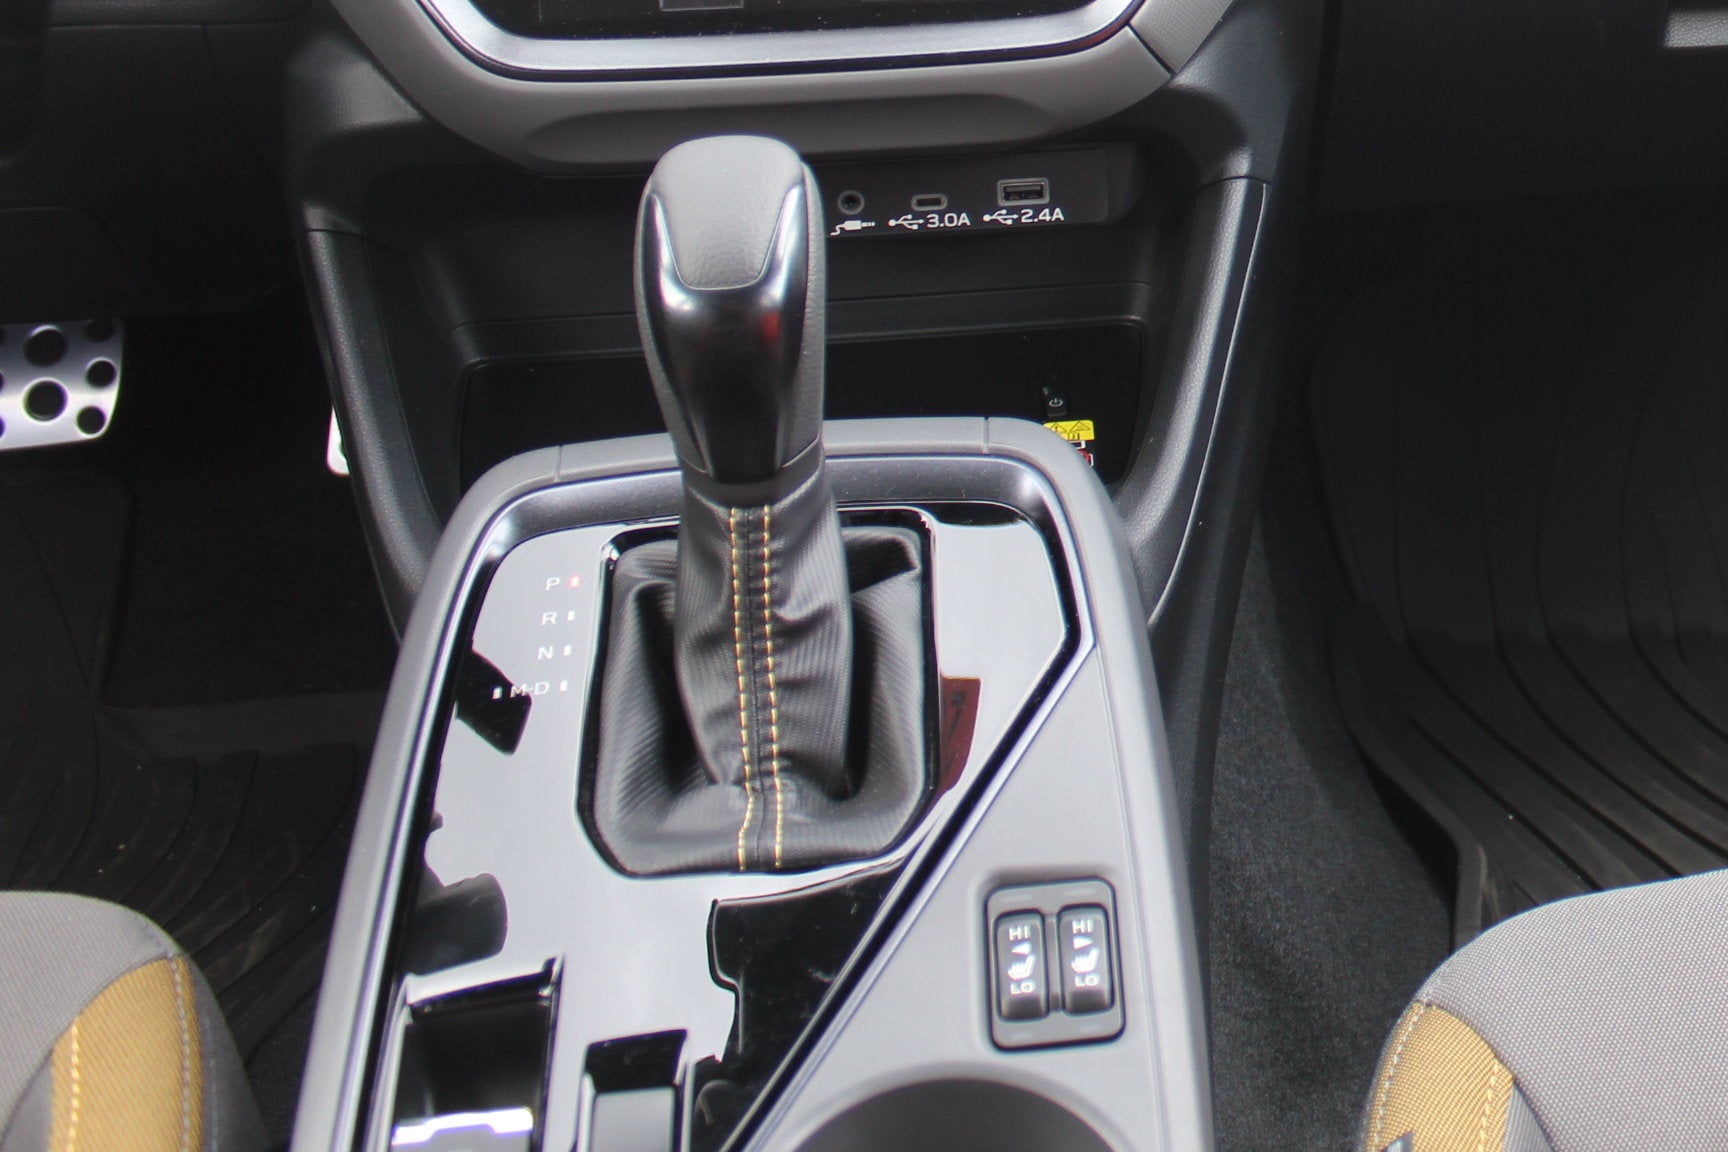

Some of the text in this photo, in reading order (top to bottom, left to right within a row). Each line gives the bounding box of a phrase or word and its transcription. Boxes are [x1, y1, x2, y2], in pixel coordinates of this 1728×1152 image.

[927, 213, 971, 228] 3.0A
[1020, 209, 1064, 223] 2.4A
[546, 578, 560, 591] P
[541, 612, 557, 625] R
[537, 646, 553, 660] N
[1009, 925, 1031, 941] HI
[1072, 920, 1093, 934] HI
[1010, 980, 1035, 995] LO
[1074, 975, 1100, 987] LO
